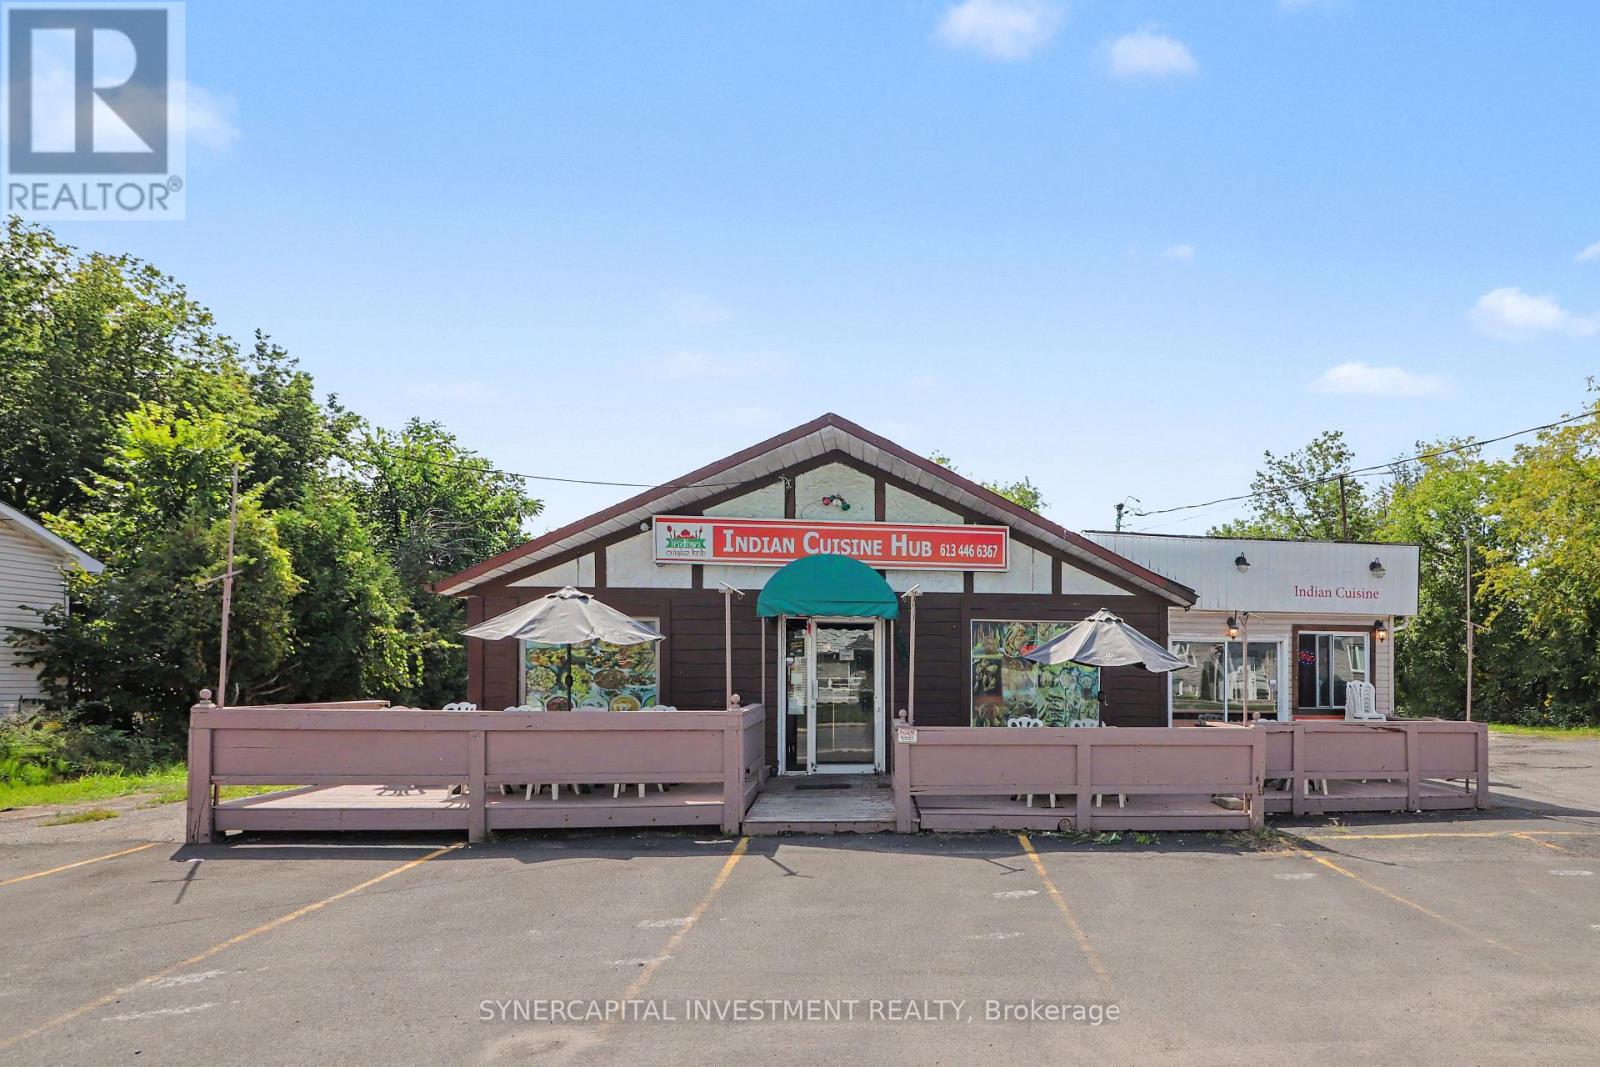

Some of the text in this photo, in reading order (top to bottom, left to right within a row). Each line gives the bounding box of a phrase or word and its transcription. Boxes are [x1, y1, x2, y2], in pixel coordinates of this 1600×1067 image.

[722, 529, 998, 558] INDIAN CUISINE HUB 613 446 6367
[1294, 585, 1379, 599] Indian Cuisine
